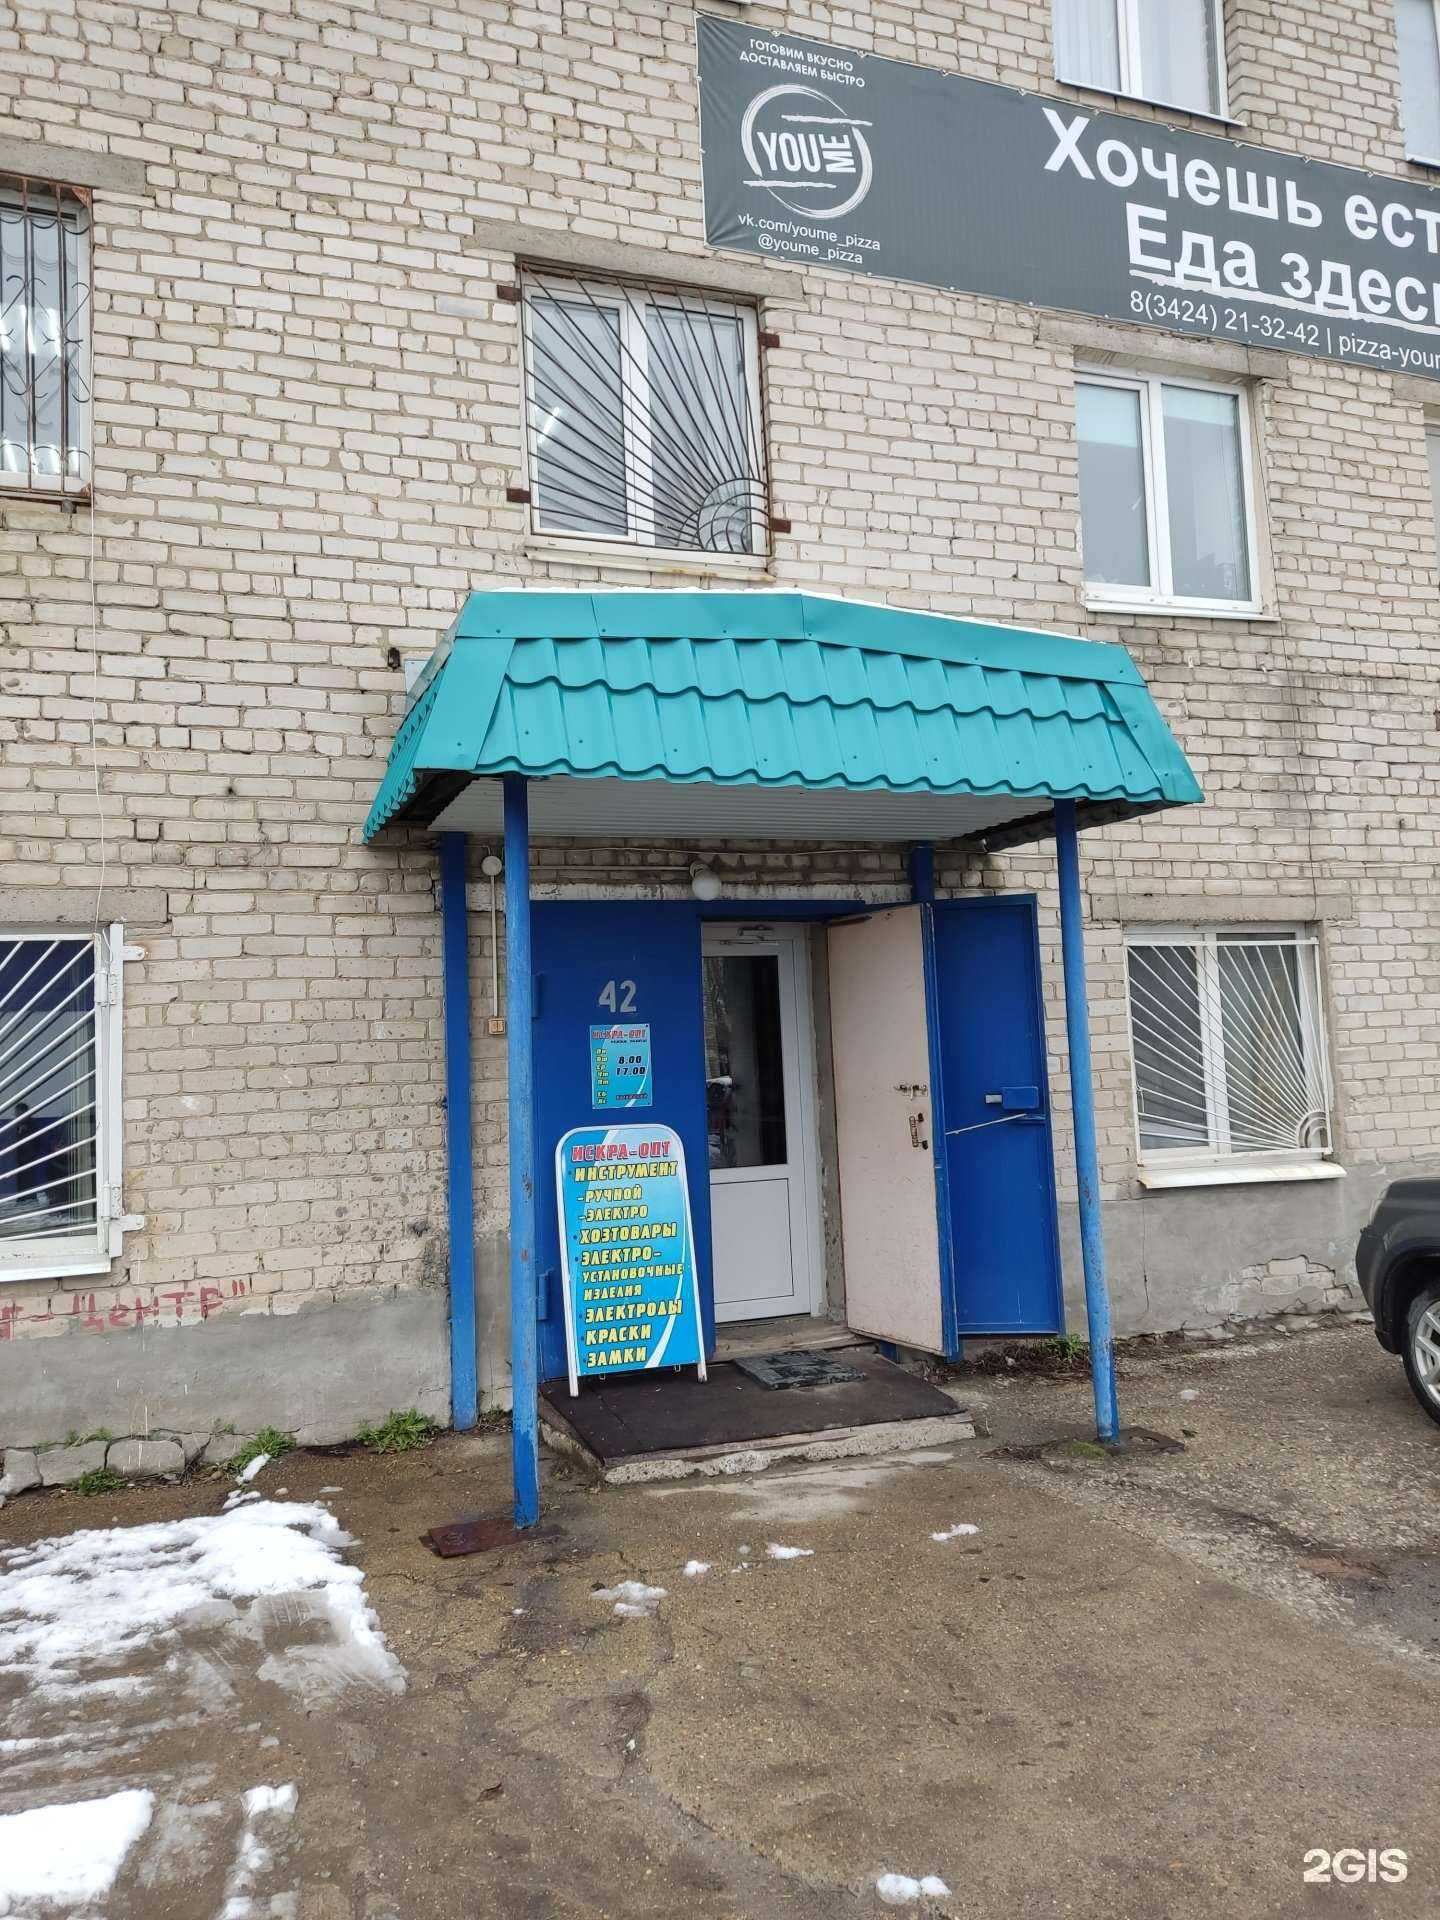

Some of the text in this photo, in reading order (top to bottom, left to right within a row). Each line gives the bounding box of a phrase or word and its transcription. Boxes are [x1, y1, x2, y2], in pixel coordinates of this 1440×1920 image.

[740, 51, 865, 87] ДОСТАВЛЯЕМ БЫСТРО
[750, 39, 853, 72] ГОТОВИМ ВКУСНО
[757, 131, 821, 172] YOU
[819, 134, 856, 173] ME
[1042, 107, 1322, 228] Хочешь
[738, 213, 881, 250] vk.com/youme_pizza
[1126, 202, 1259, 290] Еда
[758, 233, 863, 264] @youme_pizza
[1130, 291, 1217, 332] 8(3424)
[1225, 309, 1320, 346] 21-32-42
[598, 979, 637, 1013] 42
[571, 1141, 671, 1161] ИСКРА-ОПТ
[575, 1161, 678, 1182] ИНСТРУМЕНТ
[580, 1222, 677, 1244] ХОЗТОВАРЫ
[581, 1246, 662, 1266] ЭЛЕКТРО-
[583, 1263, 683, 1283] УСТАНОВОЧНЫЕ
[583, 1284, 642, 1301] ИЗДЕЛИЯ
[585, 1299, 682, 1323] ЭЛЕКТРОДЫ
[586, 1324, 651, 1346] КРАСКИ
[587, 1346, 647, 1368] ЗАМКИ
